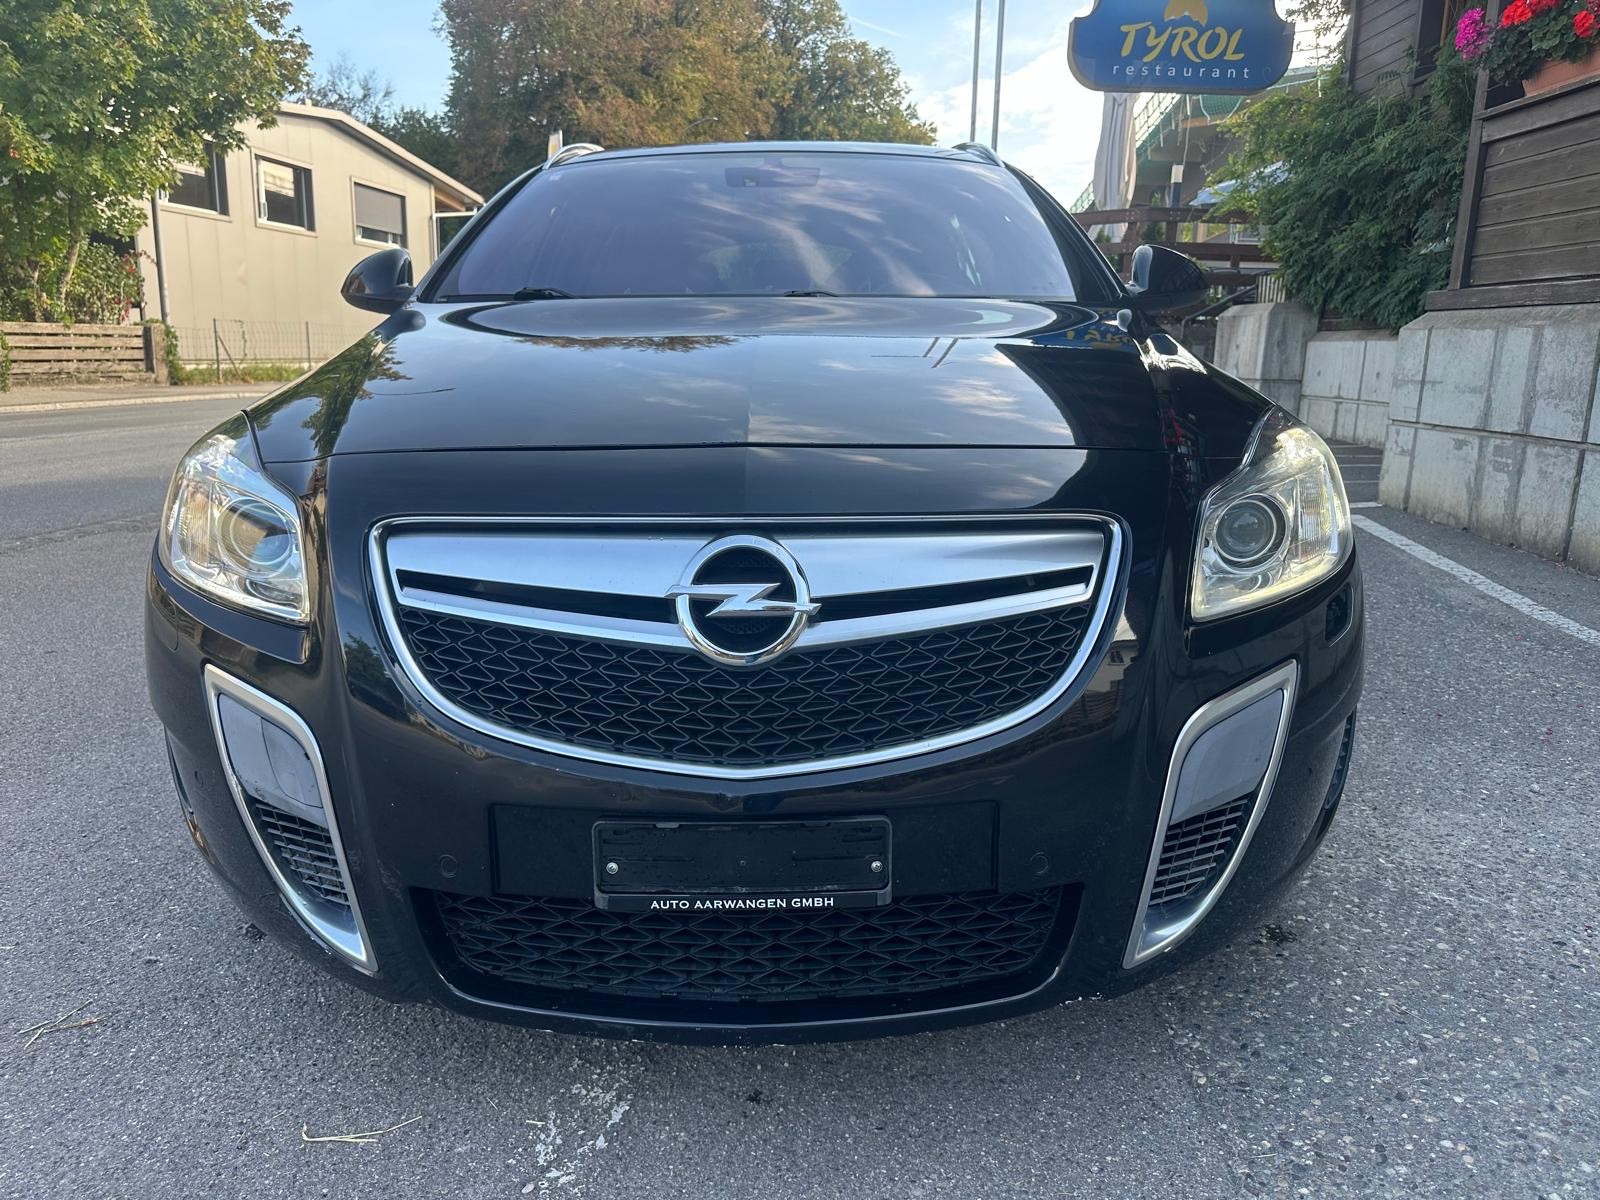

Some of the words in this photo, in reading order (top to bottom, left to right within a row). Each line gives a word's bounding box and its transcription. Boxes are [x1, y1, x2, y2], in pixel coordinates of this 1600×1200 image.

[1120, 21, 1245, 63] TYROL
[1112, 63, 1249, 79] restaurant
[650, 900, 689, 909] AUTO
[694, 898, 787, 909] AARWANGEN
[791, 897, 834, 907] GMBH
